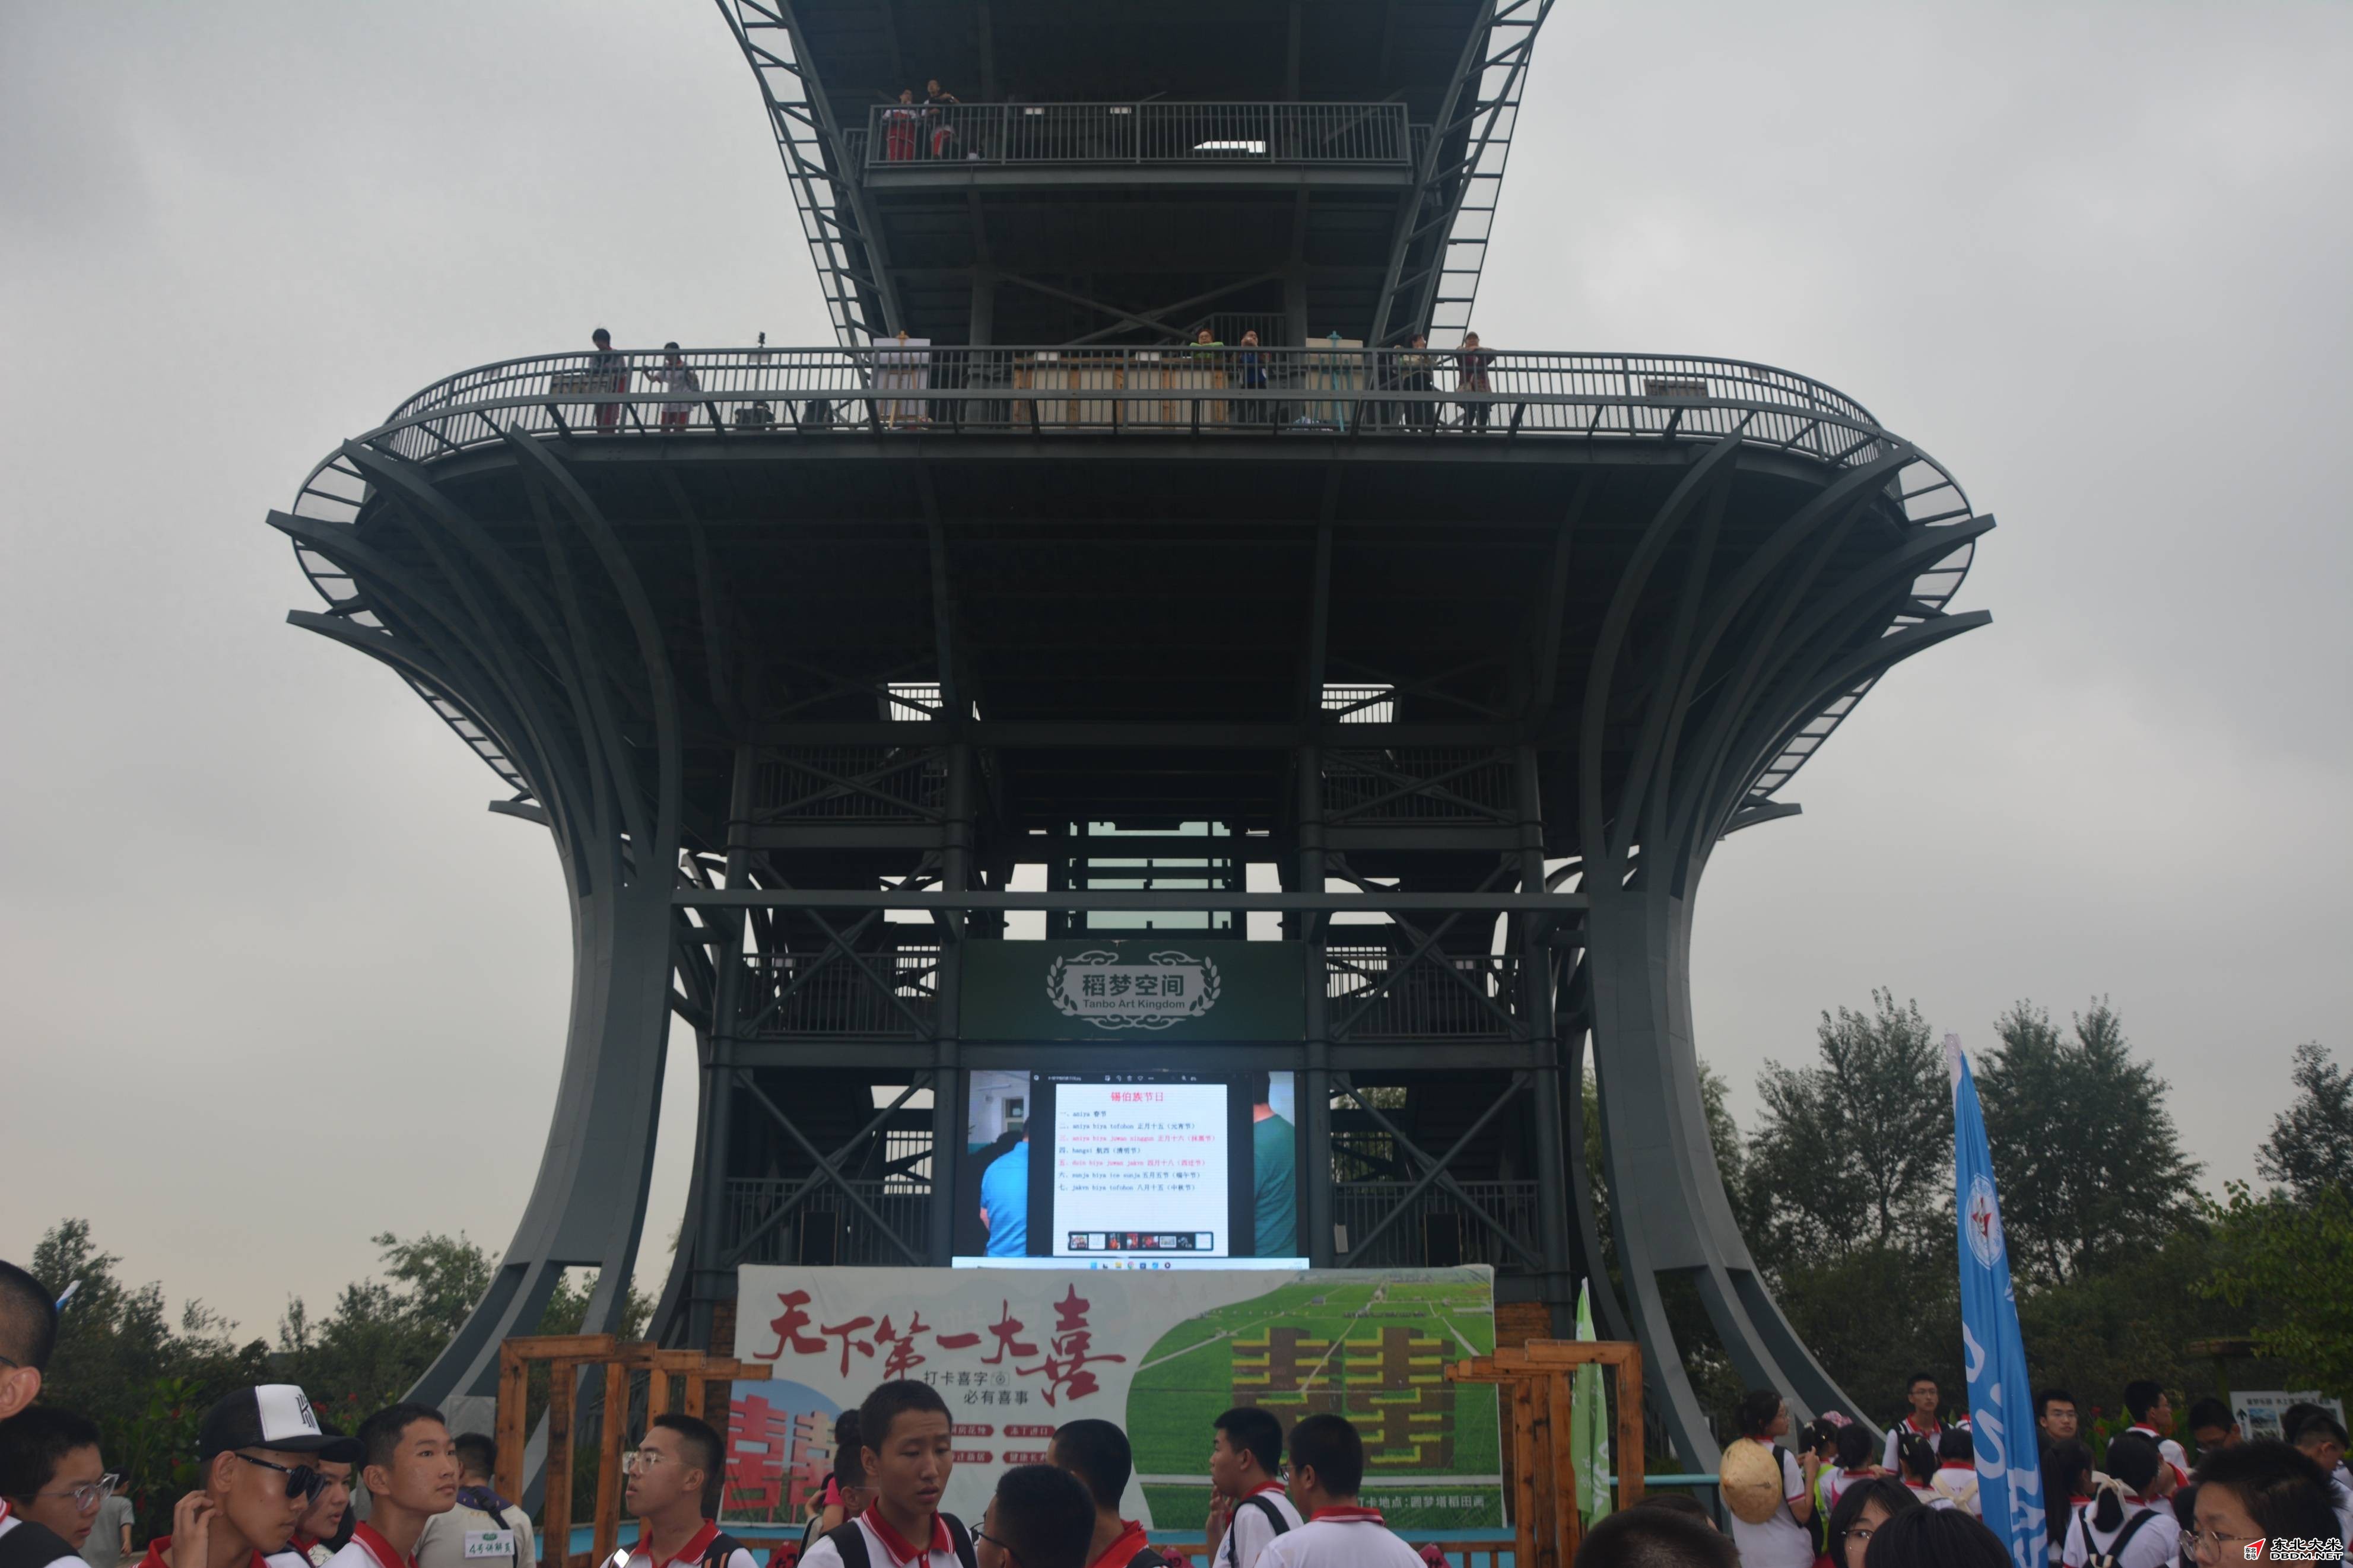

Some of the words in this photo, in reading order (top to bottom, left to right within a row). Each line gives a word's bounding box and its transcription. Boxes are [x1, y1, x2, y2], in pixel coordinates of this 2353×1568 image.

[1082, 974, 1185, 997] 稻梦空间
[1083, 1000, 1116, 1009] Tanbo
[1119, 1000, 1135, 1009] Art
[1138, 1000, 1186, 1011] Kingdom
[1110, 1091, 1164, 1102] 锡伯族节日
[752, 1282, 1127, 1408] 天下第一大喜
[923, 1370, 988, 1386] 打卡喜字
[963, 1389, 1029, 1405] 必有喜事
